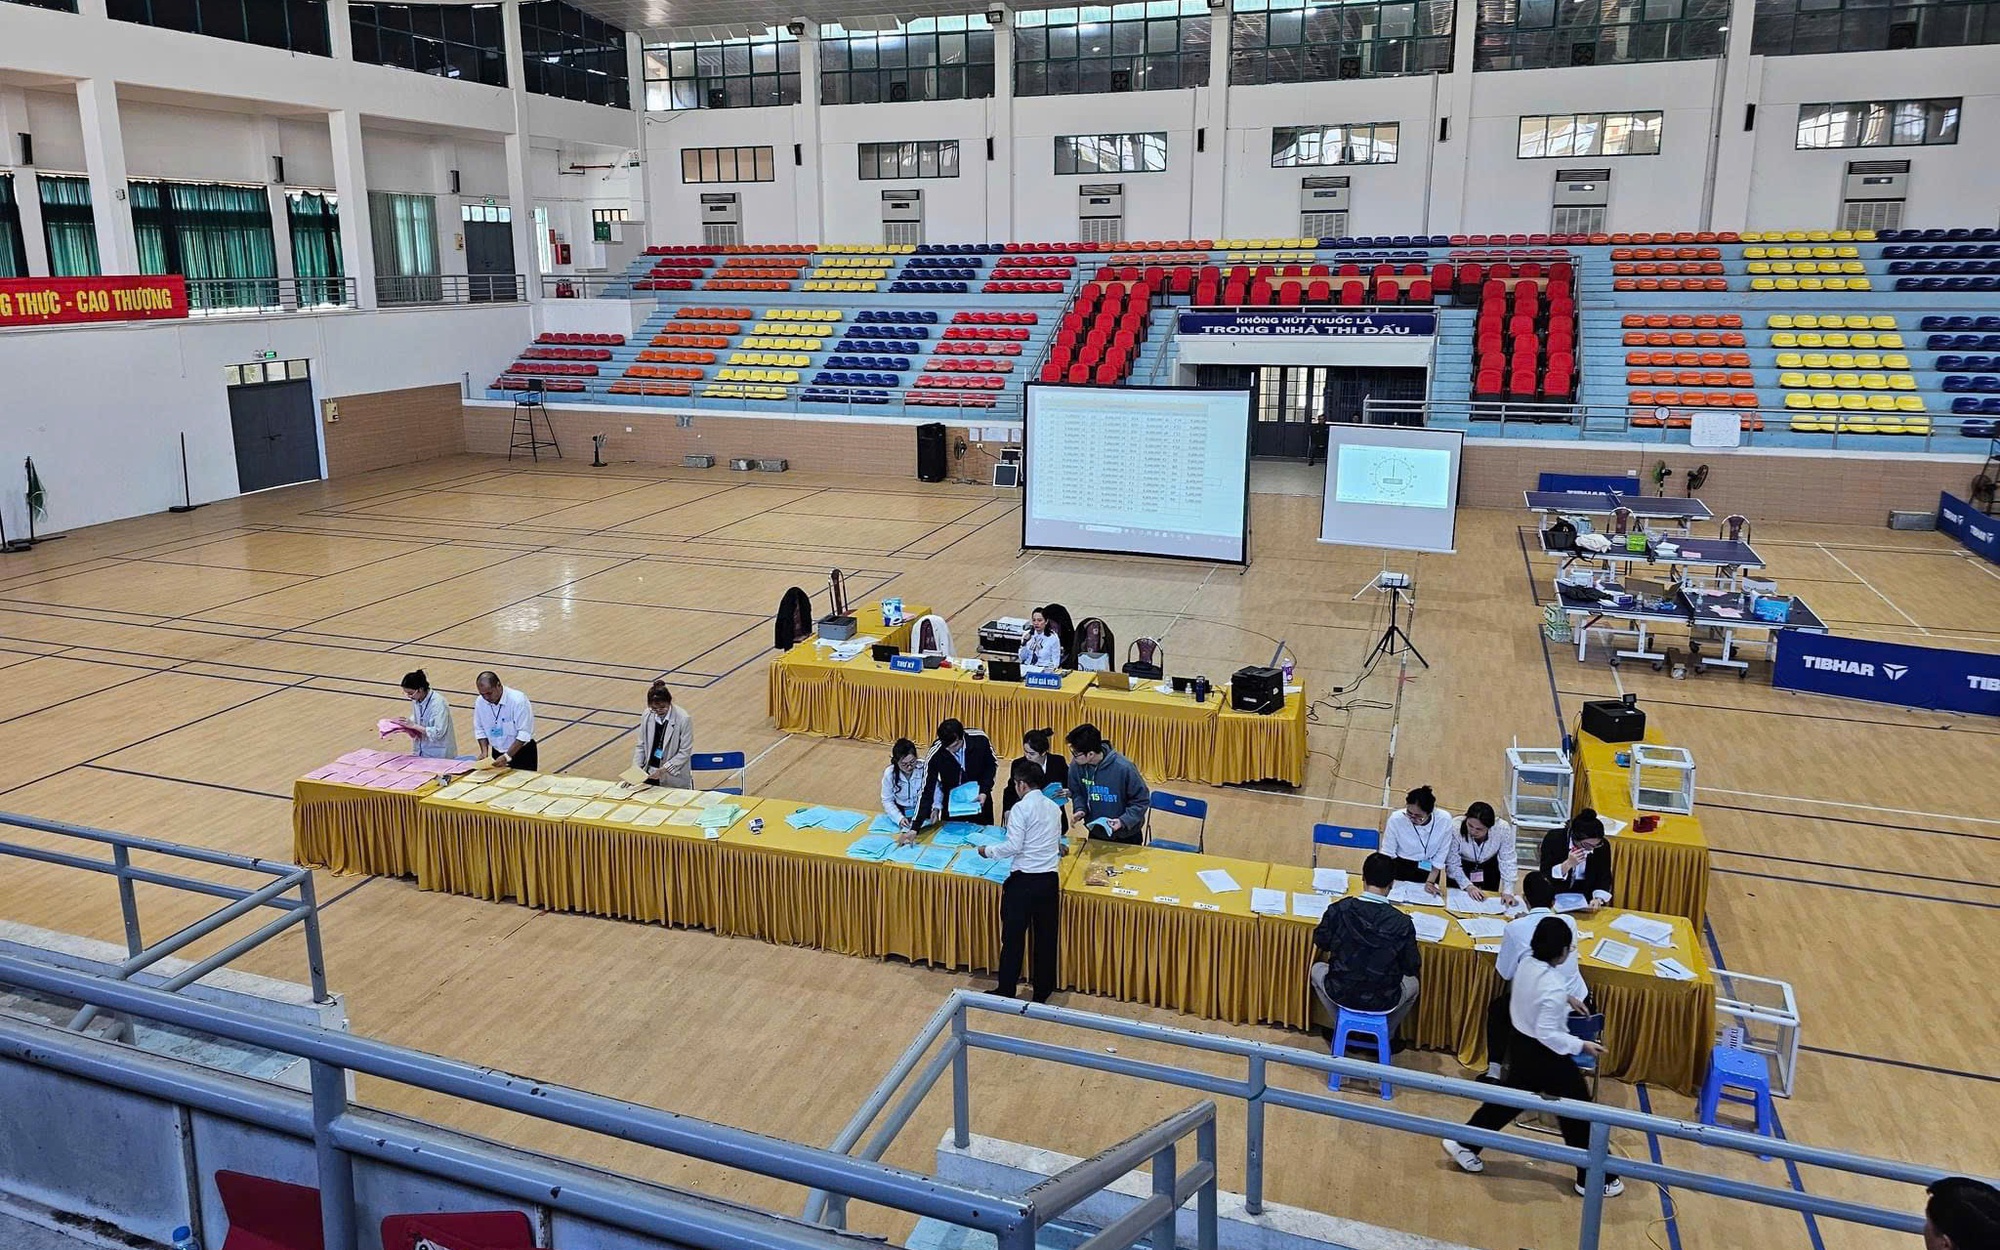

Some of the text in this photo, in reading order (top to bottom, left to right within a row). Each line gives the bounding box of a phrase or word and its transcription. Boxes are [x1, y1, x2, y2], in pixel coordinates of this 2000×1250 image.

[0, 294, 13, 317] G
[15, 289, 62, 319] THỰC
[76, 290, 110, 313] CAO
[112, 287, 173, 315] THƯỢNG
[1236, 315, 1373, 325] KHÔNG HÚT THUỐC LÁ
[1201, 326, 1269, 334] TRONG
[1275, 325, 1319, 334] NHÀ
[1364, 324, 1410, 335] ĐẤU
[1803, 655, 1875, 677] TIBHAR
